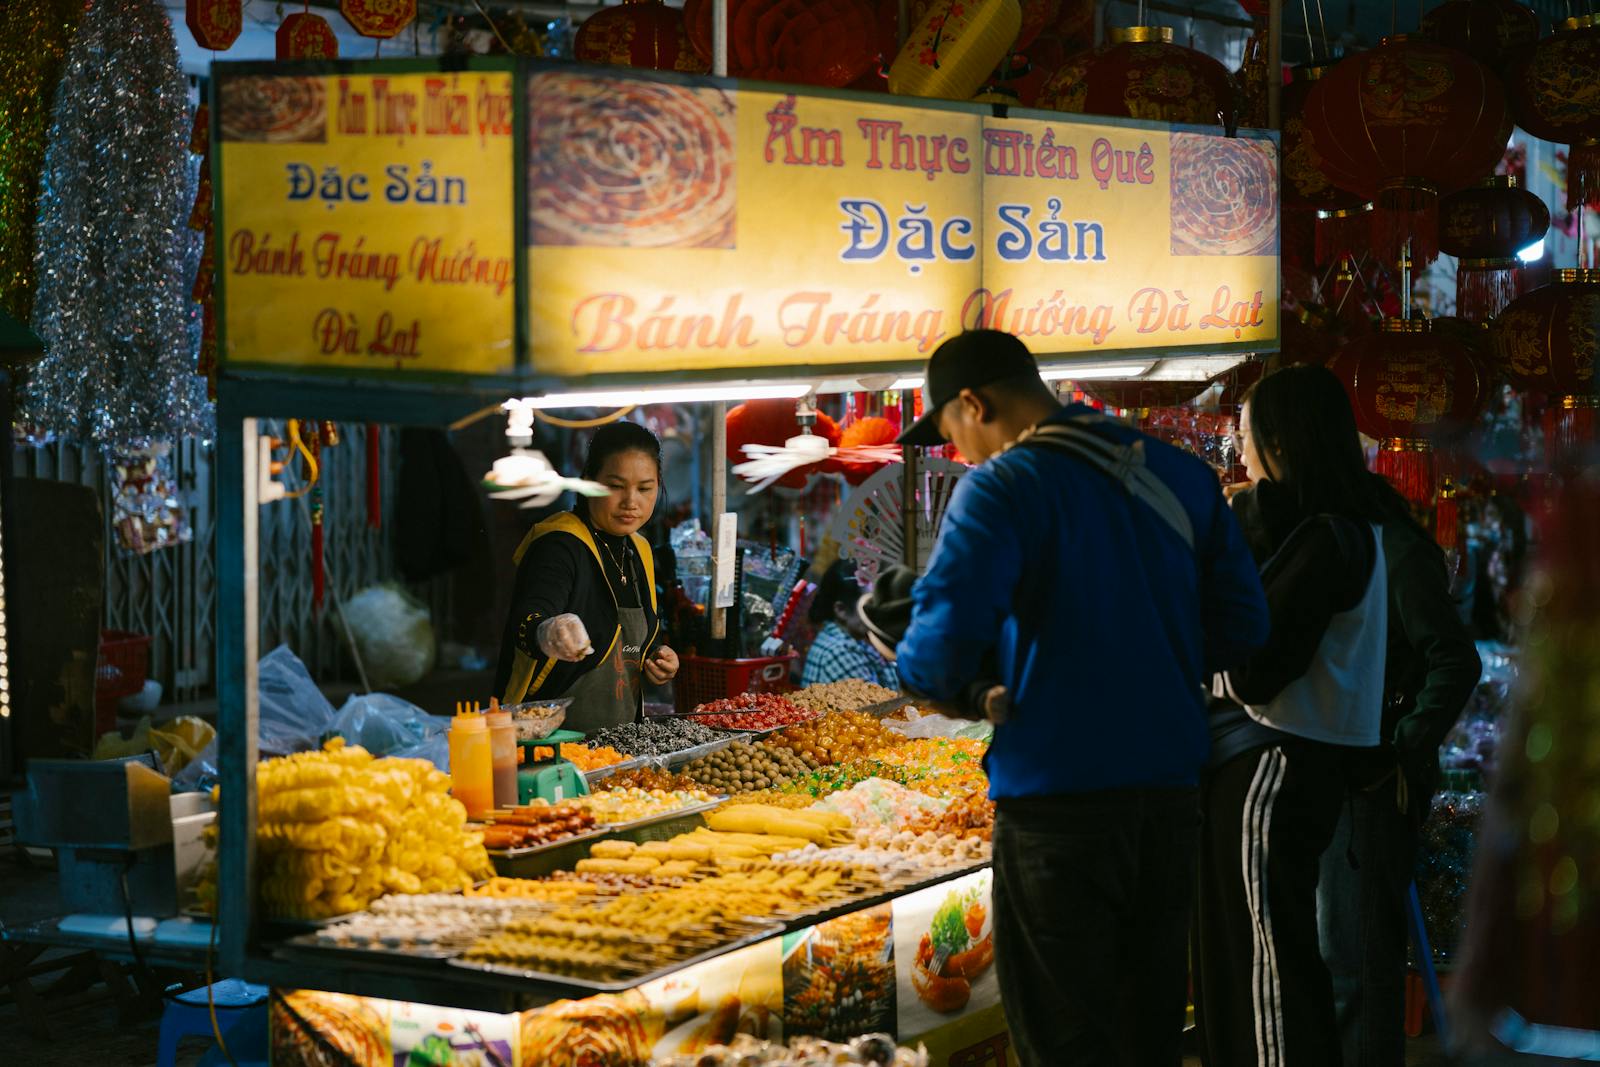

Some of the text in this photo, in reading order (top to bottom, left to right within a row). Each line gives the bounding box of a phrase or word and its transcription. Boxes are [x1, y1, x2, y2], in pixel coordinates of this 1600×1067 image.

[764, 94, 1156, 190] Ẩm Thực Miền Quê
[286, 160, 467, 211] Đặc Sản
[229, 229, 514, 297] Bánh Tráng Nướng
[839, 197, 1107, 273] Đặc Sản
[312, 307, 422, 367] Đà Lạt
[571, 284, 1265, 354] Bánh Tráng Nướng Đà Lạt
